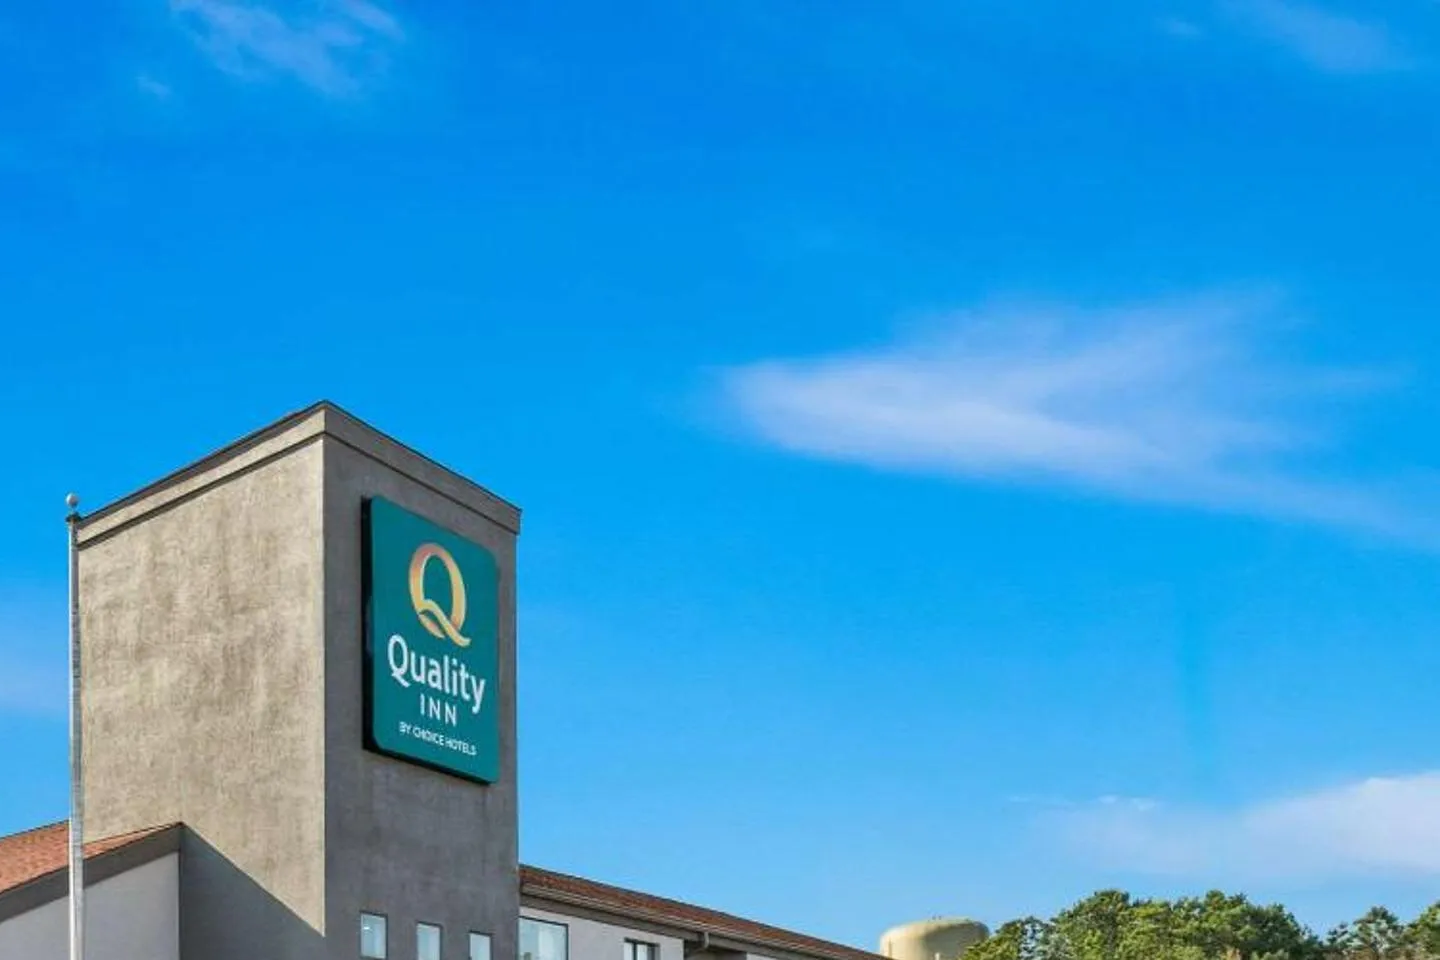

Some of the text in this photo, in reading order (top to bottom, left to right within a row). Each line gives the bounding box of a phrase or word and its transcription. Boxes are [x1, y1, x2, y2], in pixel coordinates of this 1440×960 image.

[388, 634, 486, 714] Quality
[420, 693, 458, 727] INN
[399, 721, 477, 756] BY CHOICE HOTELS
